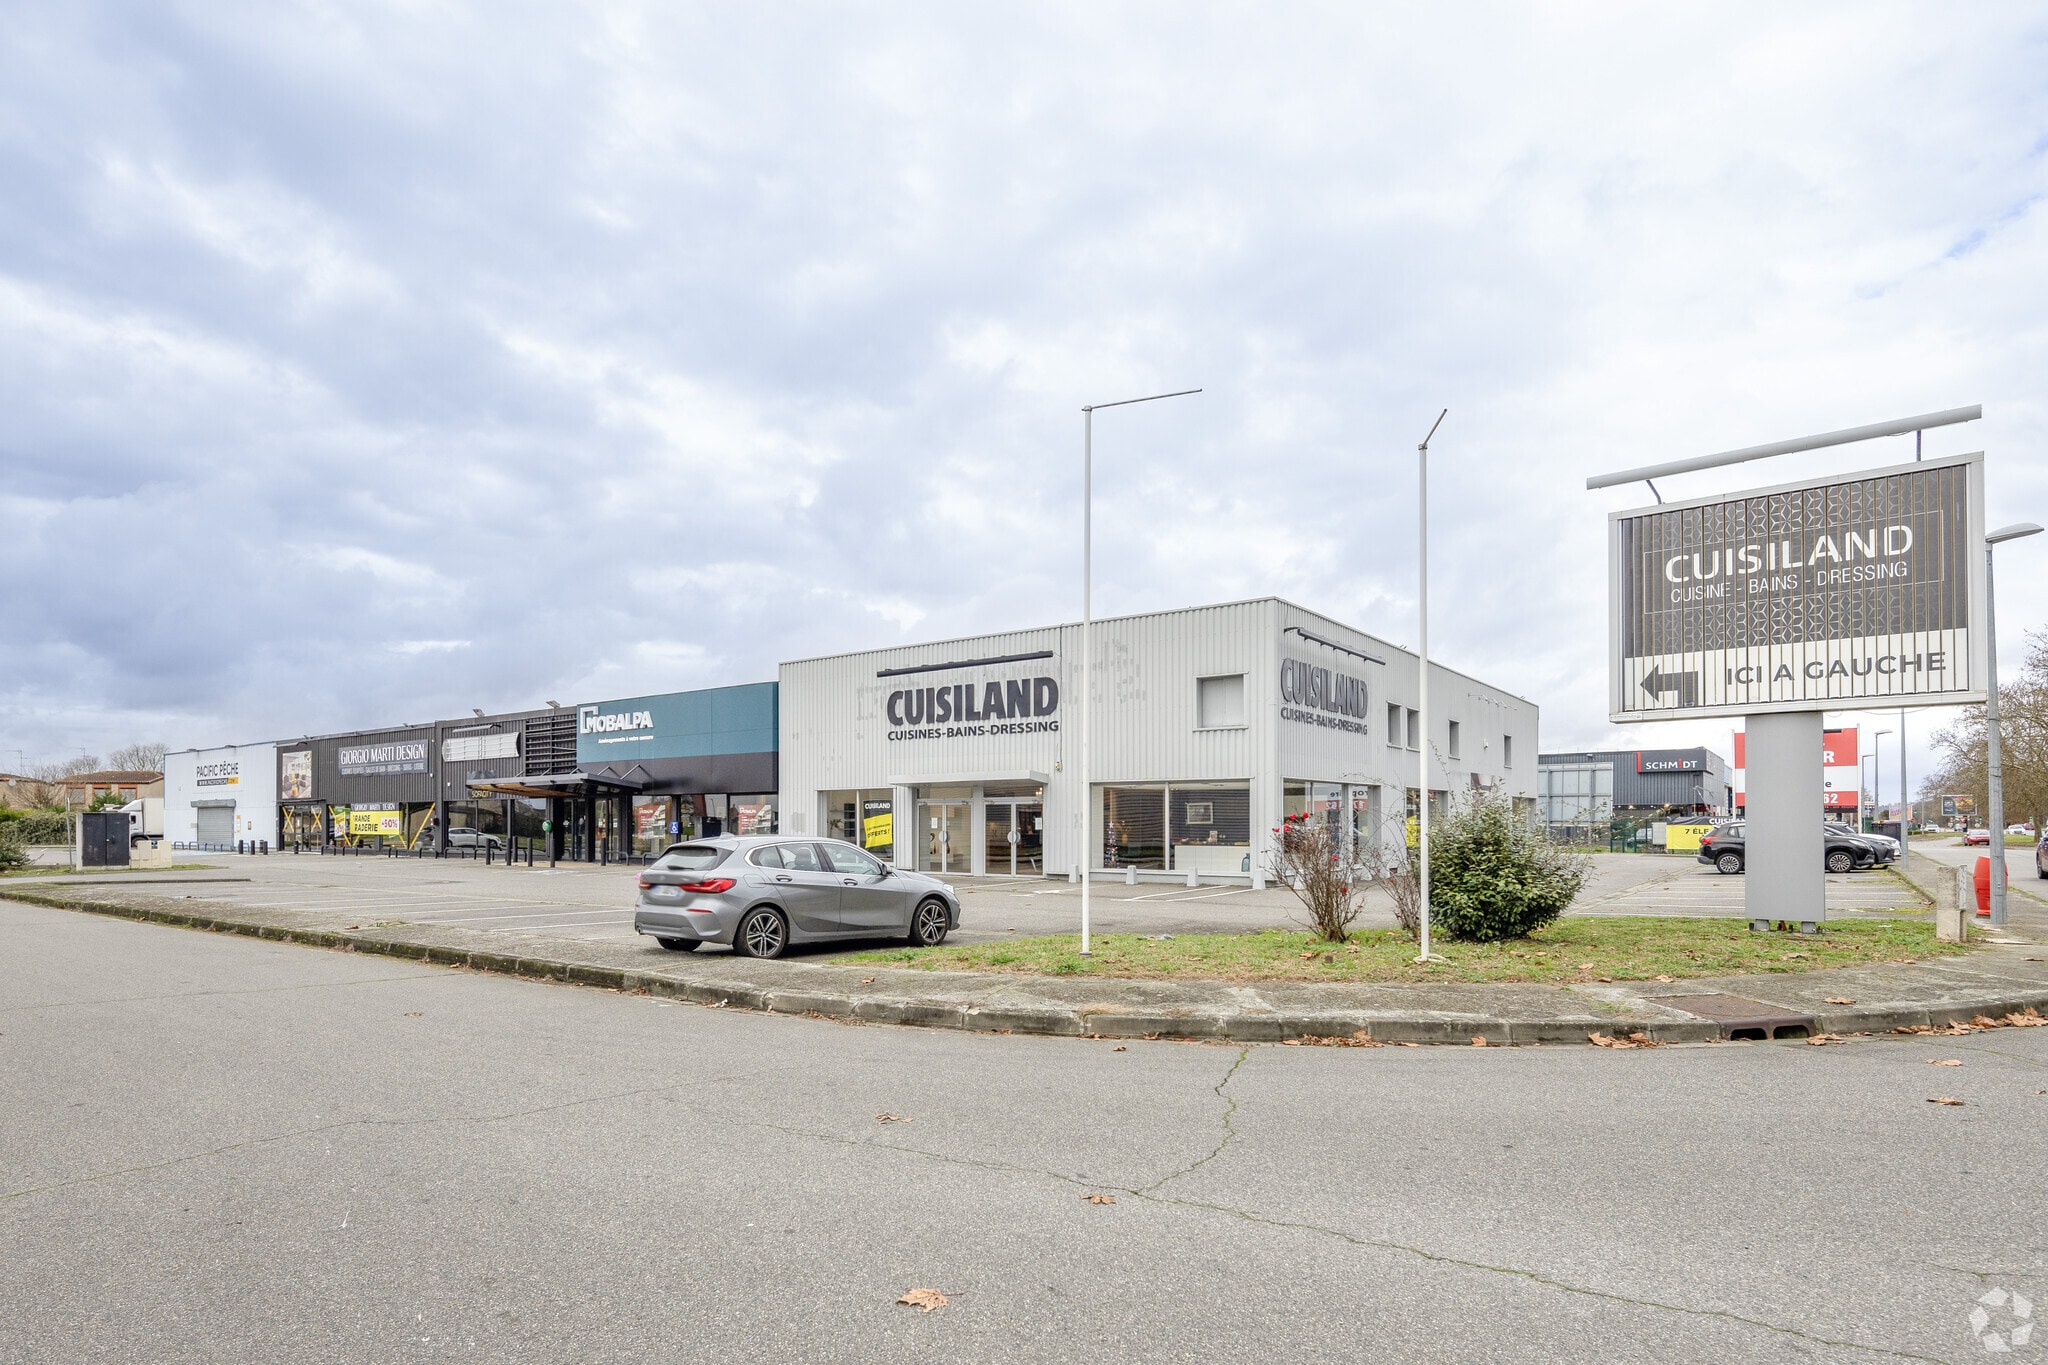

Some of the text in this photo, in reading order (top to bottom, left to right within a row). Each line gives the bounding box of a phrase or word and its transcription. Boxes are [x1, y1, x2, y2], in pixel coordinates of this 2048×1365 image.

[1665, 524, 1914, 583] CUISILAND
[1670, 580, 1731, 603] CUISINE
[1749, 573, 1798, 594] BAINS
[1817, 561, 1908, 587] DRESSING
[1727, 651, 1947, 686] ICI A GAUCHE
[886, 676, 1059, 726] CUISILAND
[1280, 657, 1369, 719] CUISILAND
[586, 711, 654, 733] MOBALPA
[196, 760, 239, 778] PACIFIC PÊCHE
[340, 744, 425, 765] GIORGIO MARTI DESIGN
[381, 819, 398, 829] -50%
